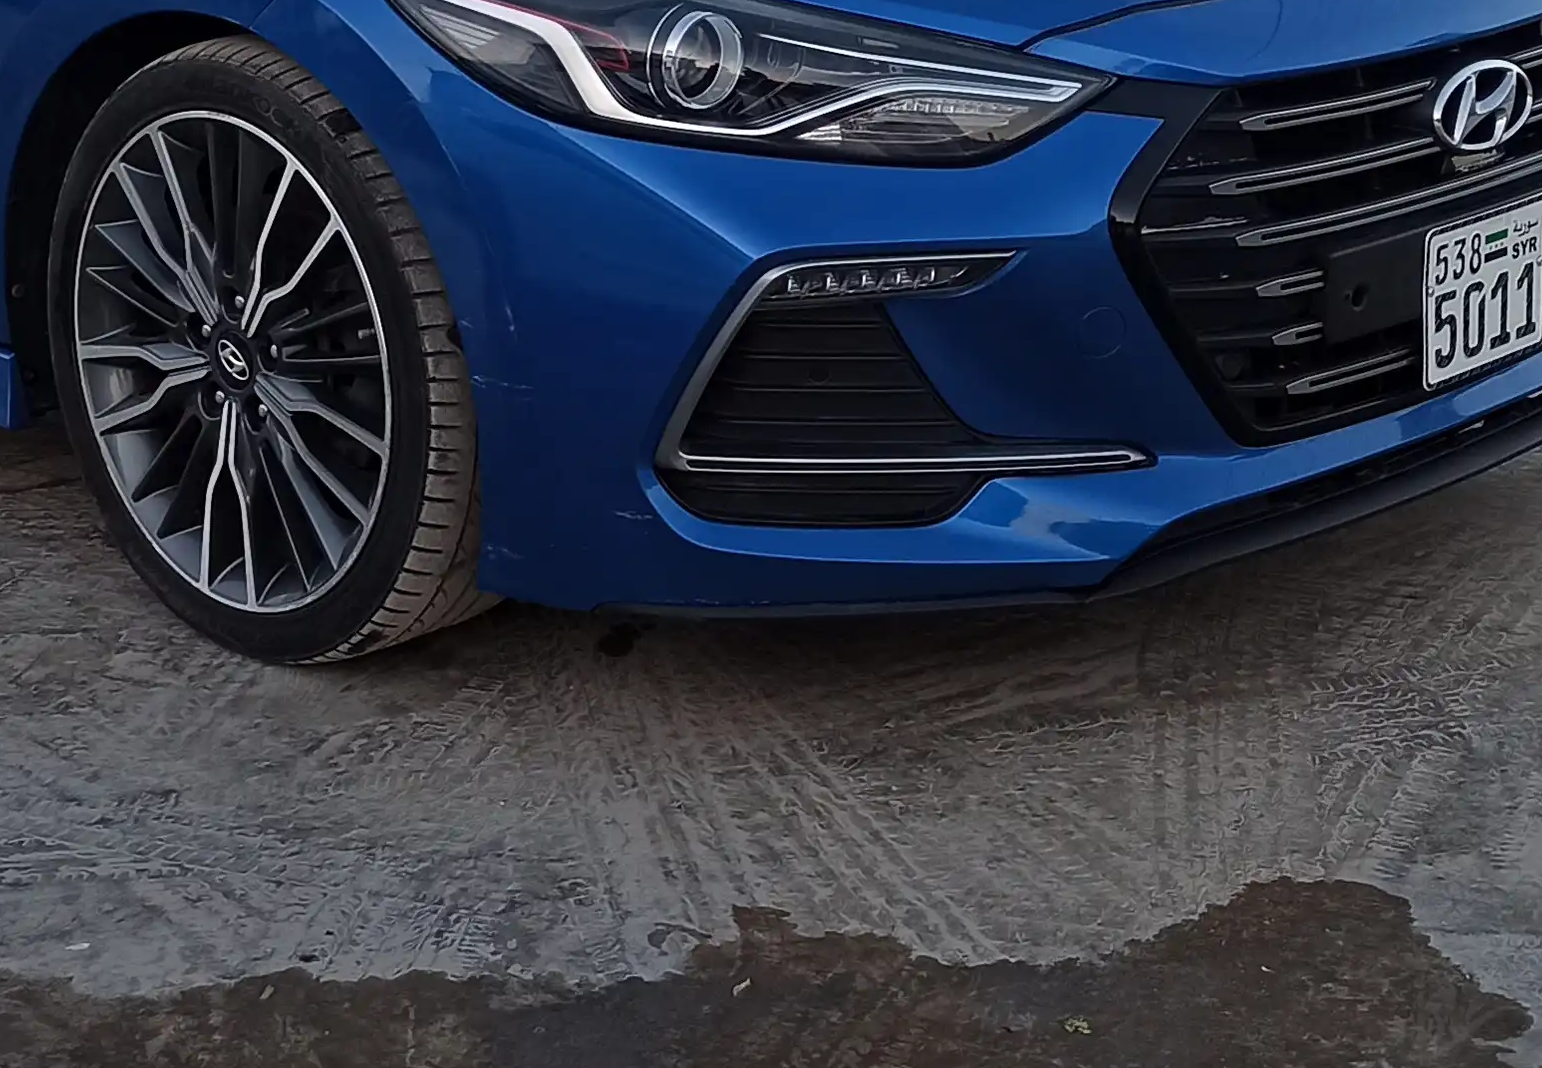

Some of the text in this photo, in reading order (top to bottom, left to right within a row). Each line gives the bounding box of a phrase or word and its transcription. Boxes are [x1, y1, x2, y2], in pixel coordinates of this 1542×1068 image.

[1512, 218, 1539, 237] سورية
[1434, 232, 1483, 286] 538
[1511, 236, 1538, 260] SYR
[1434, 261, 1537, 369] 5011
